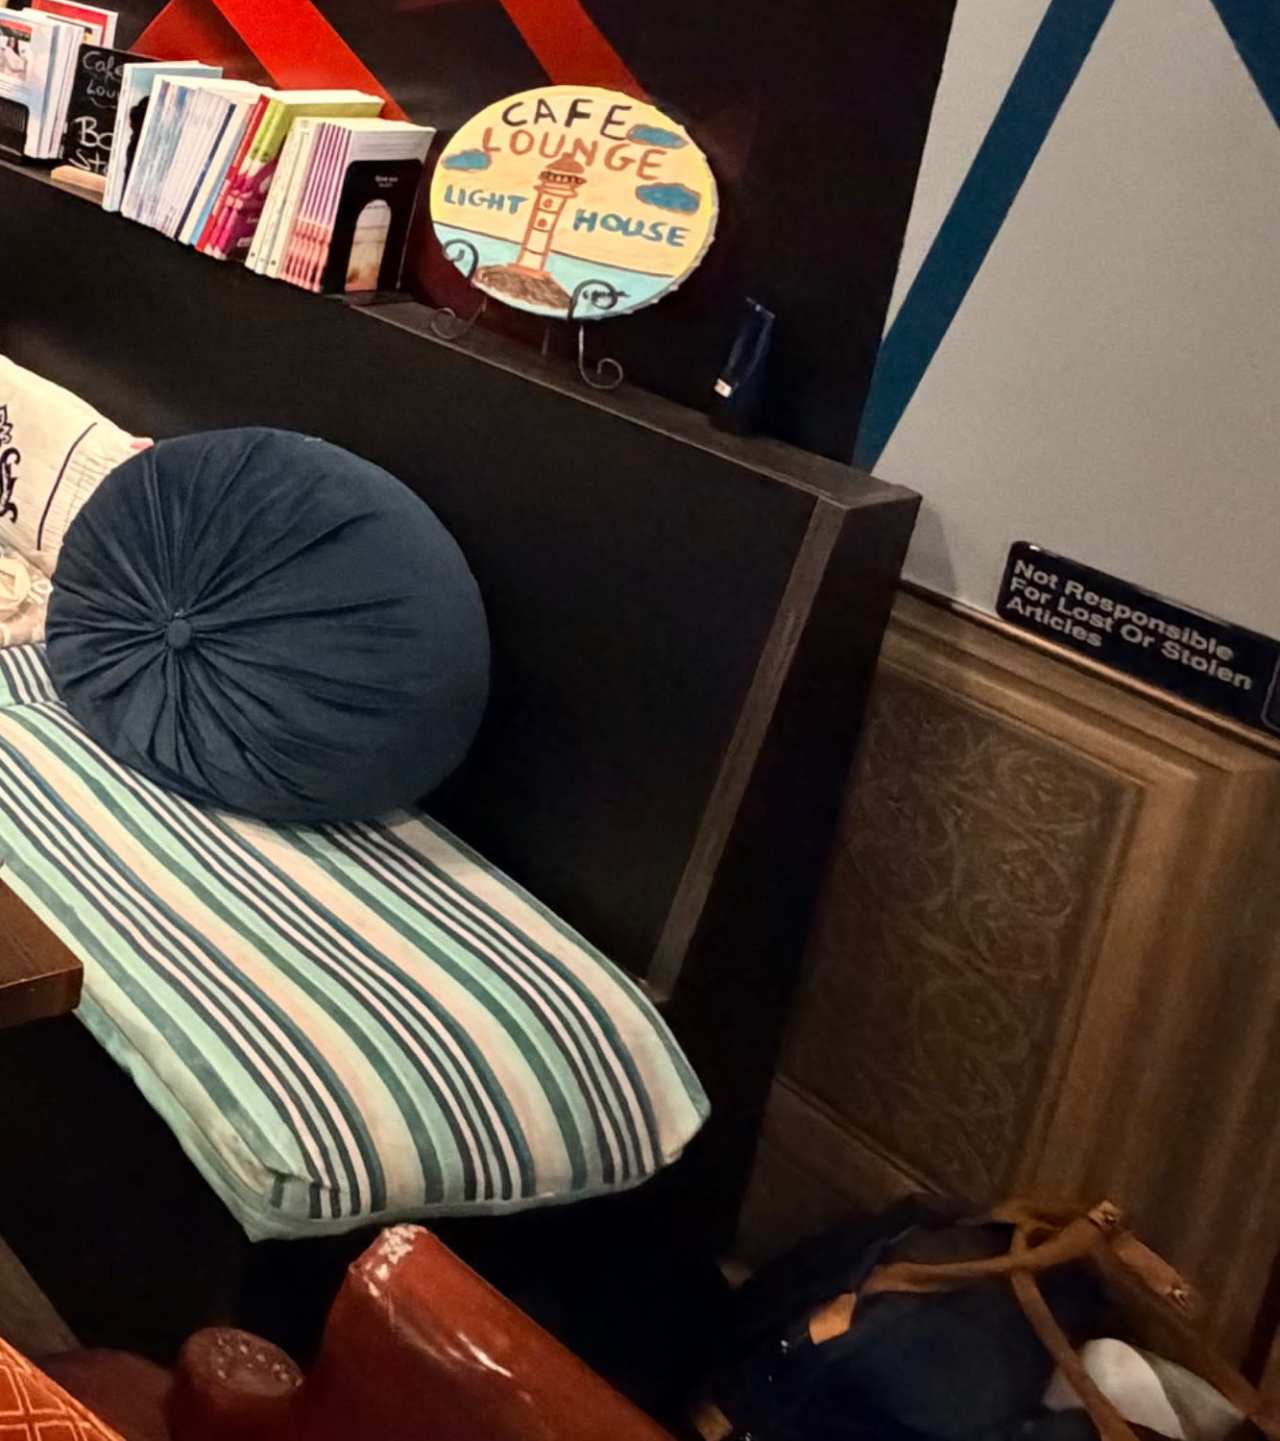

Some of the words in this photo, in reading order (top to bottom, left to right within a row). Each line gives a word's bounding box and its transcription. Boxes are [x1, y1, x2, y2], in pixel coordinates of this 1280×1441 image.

[502, 97, 632, 140] CAFE
[482, 127, 667, 180] LOUNGE
[443, 185, 529, 215] LIGHT
[572, 209, 691, 248] HOUSE
[1005, 596, 1103, 648] Articles
[1009, 576, 1051, 606] For
[1057, 596, 1116, 634] Lost
[1119, 624, 1156, 648] Or
[1160, 640, 1253, 691] Stolen
[1013, 559, 1058, 590] Not
[1064, 579, 1236, 661] Responsible
